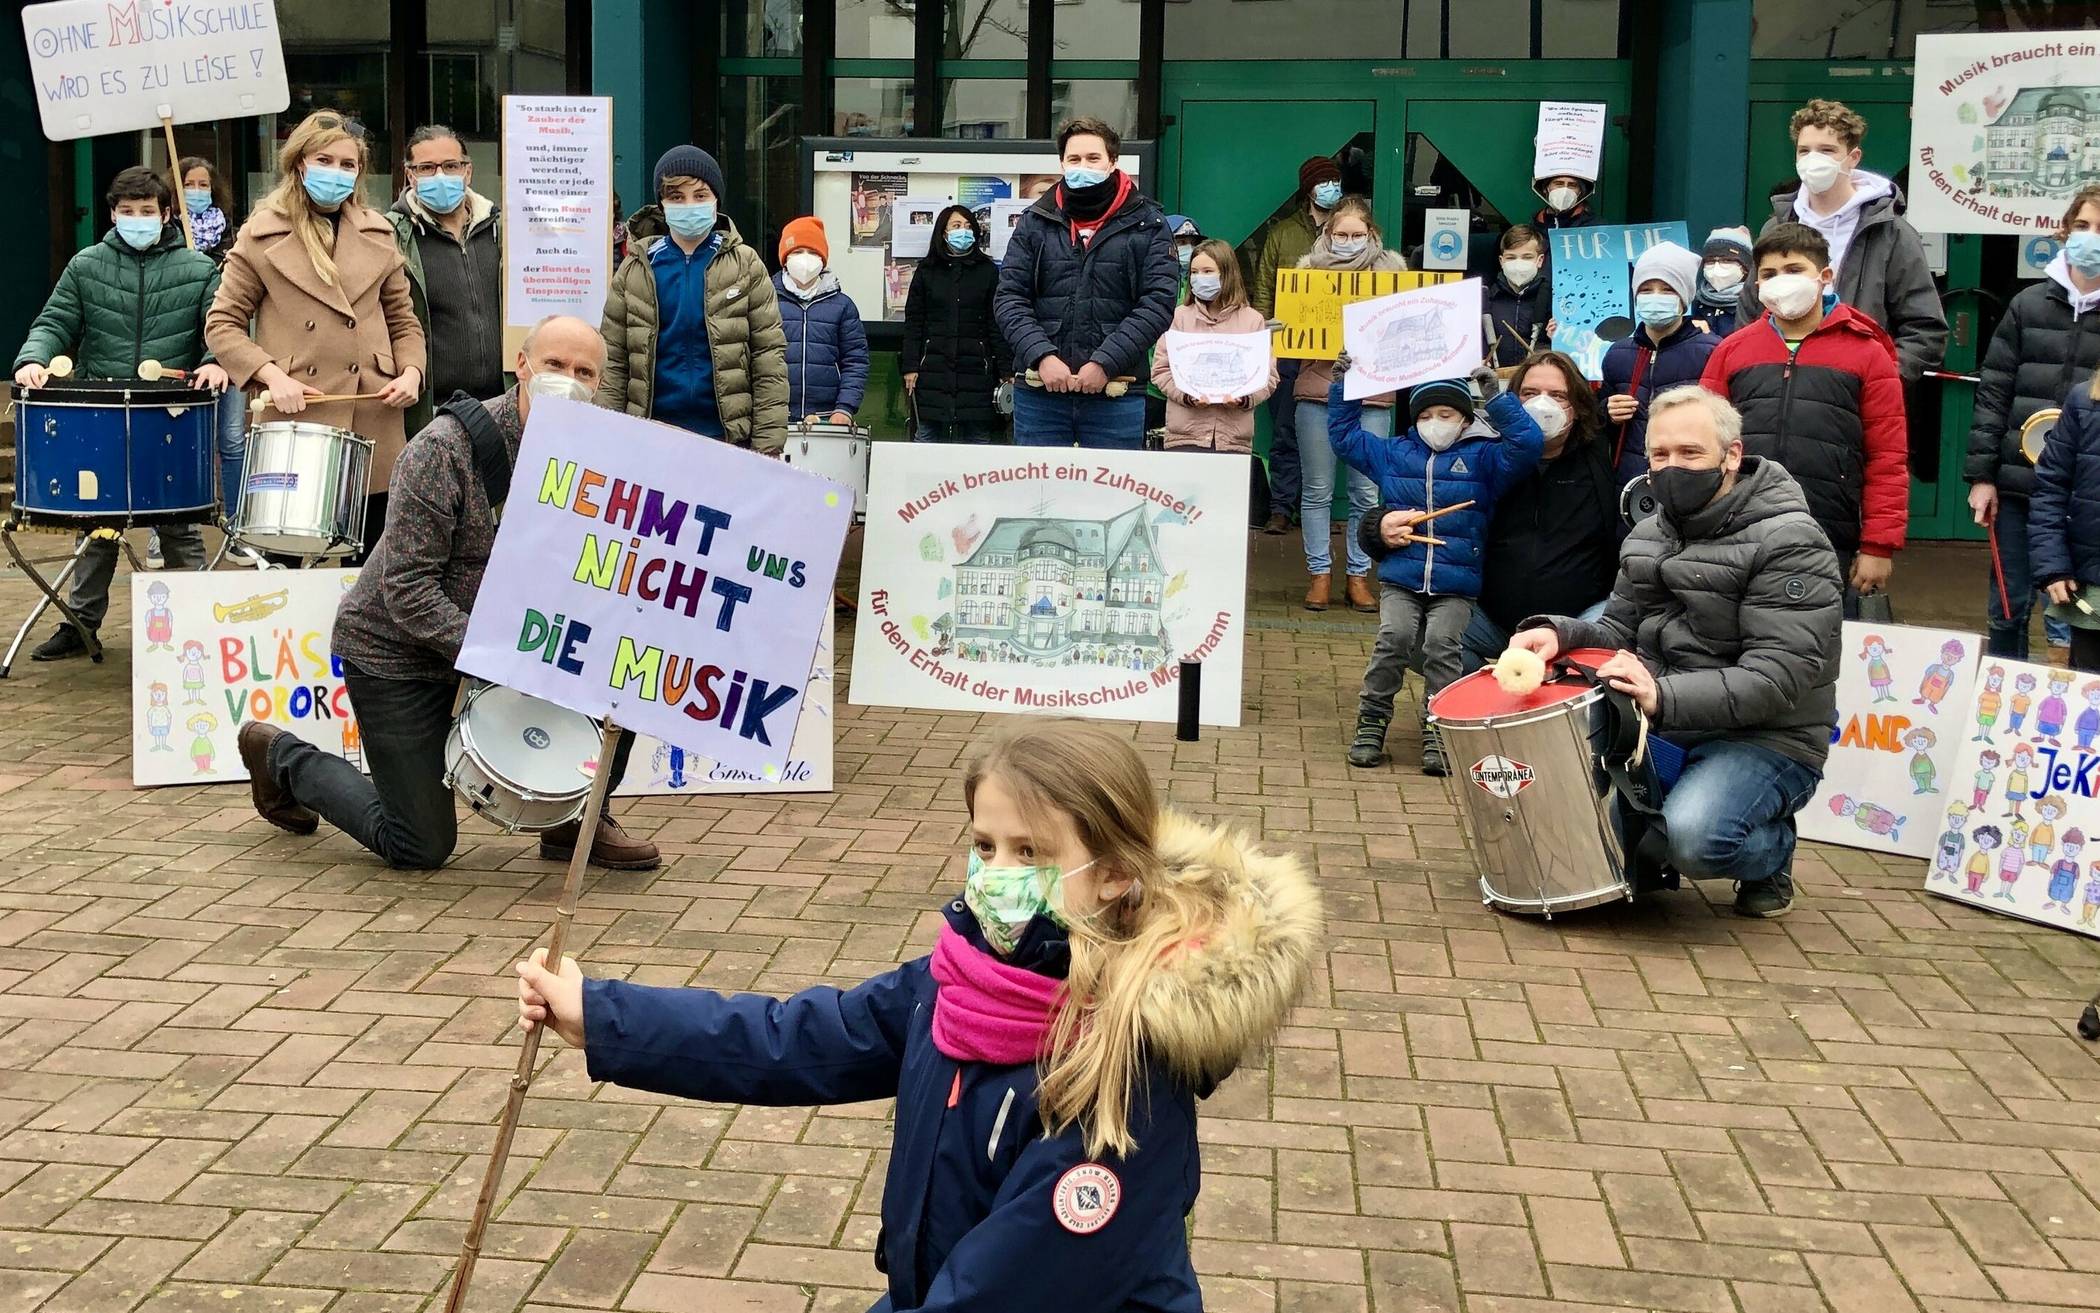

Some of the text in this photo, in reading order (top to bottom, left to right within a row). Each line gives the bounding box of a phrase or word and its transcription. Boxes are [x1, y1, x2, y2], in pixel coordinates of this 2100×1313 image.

[34, 22, 99, 57] OHNE
[100, 70, 126, 95] ES
[140, 64, 168, 90] ZU
[250, 49, 264, 78] !
[1938, 43, 2096, 96] Musik braucht ein
[535, 105, 561, 113] stark
[564, 105, 577, 113] ist
[568, 116, 586, 124] der
[529, 156, 585, 164] mächtiger
[572, 178, 594, 186] jede
[1920, 146, 1934, 167] für
[1929, 169, 1953, 195] den
[1952, 189, 1999, 220] Erhalt
[2002, 211, 2032, 226] der
[1559, 230, 1613, 260] FÜR
[897, 462, 1203, 525] Musik braucht ein Zuhause!!
[538, 457, 806, 588] NEHMT UNS
[871, 589, 1232, 707] für den Erhalt der Musikschule Metmann
[1472, 769, 1534, 782] CONTEMPORANEA
